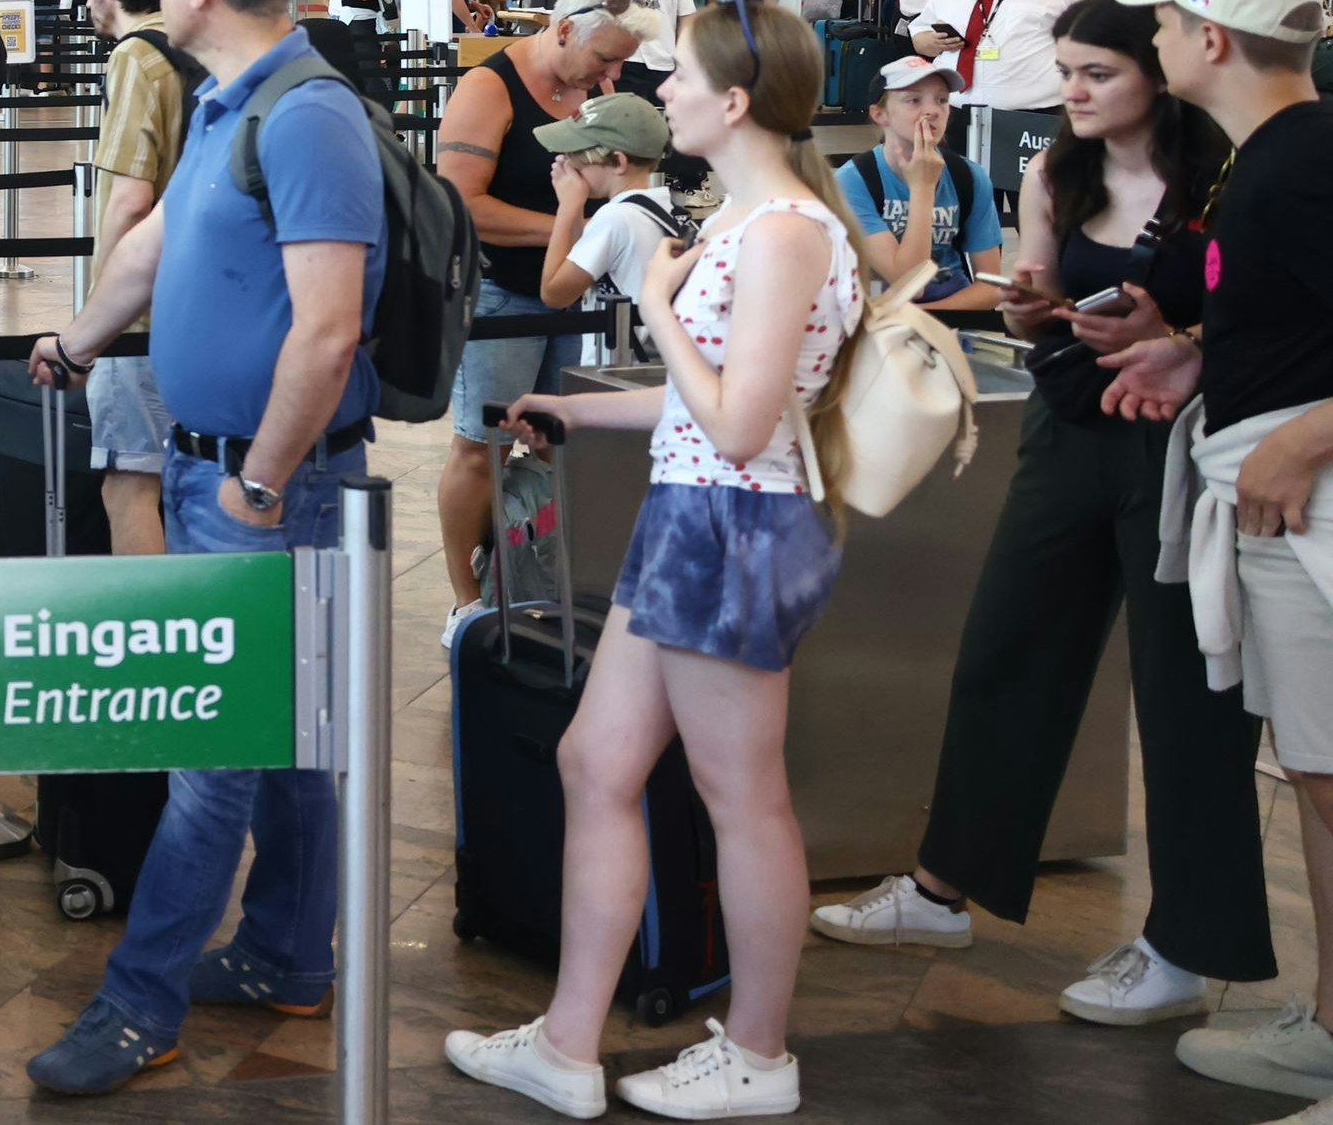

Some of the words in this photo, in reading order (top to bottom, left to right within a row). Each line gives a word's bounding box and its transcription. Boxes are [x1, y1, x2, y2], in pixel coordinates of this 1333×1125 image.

[1019, 131, 1055, 151] Aus
[3, 608, 235, 667] Eingang
[3, 681, 222, 726] Entrance
